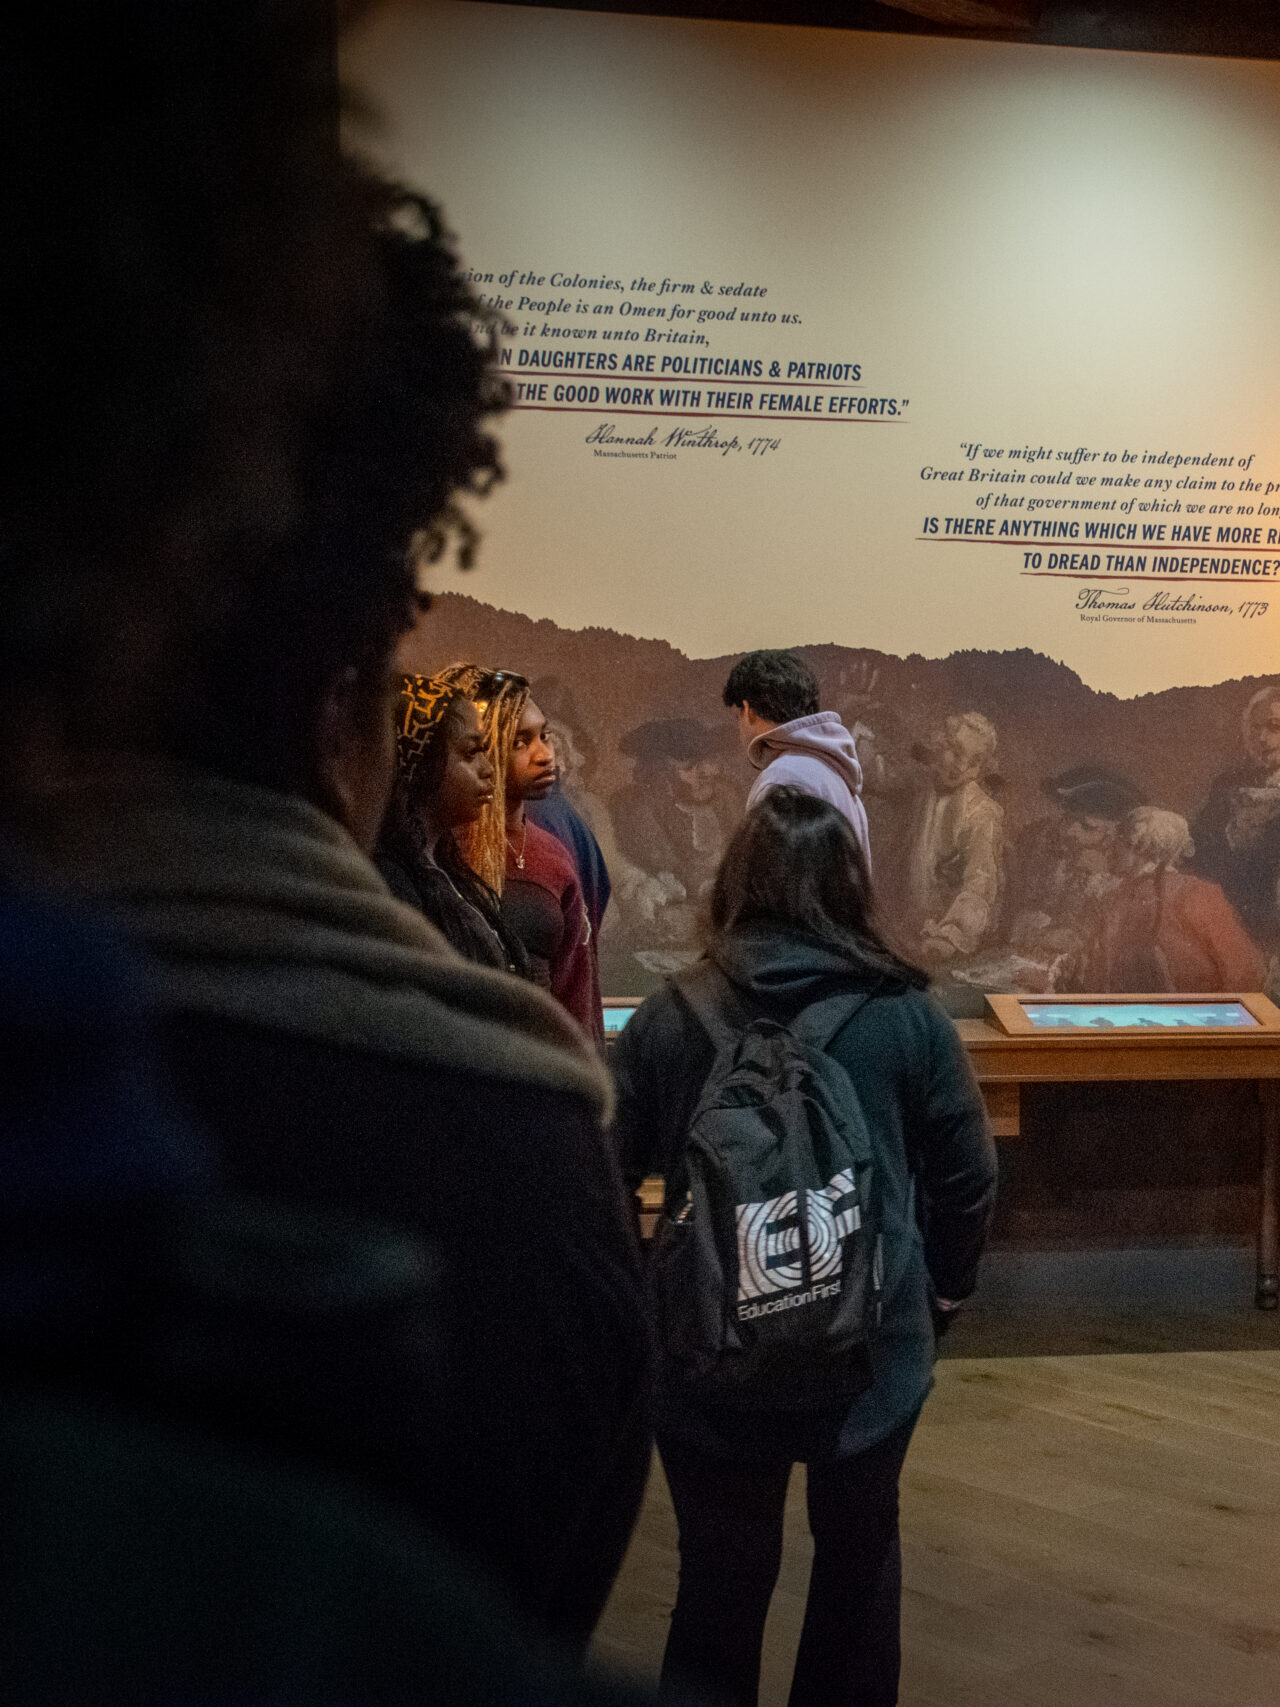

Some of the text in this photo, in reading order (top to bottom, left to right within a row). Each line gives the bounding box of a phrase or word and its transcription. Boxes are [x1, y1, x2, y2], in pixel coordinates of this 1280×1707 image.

[499, 270, 519, 288] of
[519, 271, 546, 286] the
[550, 273, 624, 293] Colonies,
[630, 277, 656, 292] the
[656, 278, 695, 296] firm
[700, 281, 712, 295] &
[718, 282, 767, 297] sedate
[487, 296, 512, 312] the
[518, 297, 571, 315] People
[576, 299, 589, 313] is
[593, 305, 613, 315] an
[619, 302, 666, 317] Omen
[667, 304, 695, 321] for
[697, 307, 736, 323] good
[740, 312, 776, 323] unto
[781, 313, 804, 326] us.
[501, 323, 518, 336] be
[523, 321, 536, 337] it
[540, 323, 597, 339] known
[602, 330, 639, 341] unto
[644, 328, 709, 346] Britain,
[519, 350, 617, 370] DAUGHTERS
[622, 354, 656, 372] ARE
[661, 356, 762, 376] POLITICIANS
[769, 361, 780, 377] &
[787, 361, 861, 381] PATRIOTS
[518, 384, 909, 416] THE GOOD WORK WITH THEIR FEMALE EFFORTS.”
[585, 423, 781, 456] Hannah Winthrop, 1774
[593, 449, 677, 460] Massachusetts Patriot
[983, 449, 1004, 458] we
[1008, 445, 1053, 463] might
[1056, 447, 1100, 465] suffer
[1103, 451, 1117, 462] to
[1121, 449, 1138, 463] be
[1142, 450, 1234, 468] independent
[1238, 454, 1256, 471] of
[920, 466, 964, 481] Great
[968, 468, 1025, 483] Britain
[1030, 471, 1073, 485] could
[1076, 476, 1096, 485] we
[1101, 474, 1140, 487] make
[1144, 479, 1172, 492] any
[1176, 476, 1217, 490] claim
[1221, 480, 1235, 490] to
[1239, 478, 1262, 492] the
[976, 493, 994, 510] of
[994, 493, 1025, 507] that
[1027, 499, 1116, 511] government
[1120, 498, 1137, 514] of
[1138, 499, 1181, 512] which
[1186, 504, 1206, 513] we
[1209, 505, 1233, 514] are
[1237, 506, 1254, 515] no
[923, 517, 939, 534] IS
[945, 518, 996, 535] THERE
[998, 520, 1079, 538] ANYTHING
[1085, 522, 1137, 539] WHICH
[1143, 524, 1166, 540] WE
[1171, 525, 1212, 542] HAVE
[1216, 527, 1262, 543] MORE
[1024, 553, 1042, 569] TO
[1048, 553, 1100, 570] DREAD
[1107, 555, 1147, 572] THAN
[1075, 587, 1269, 618] Thomas Hutchinson, 1773
[1080, 614, 1100, 623] Royal
[1147, 616, 1196, 624] Massachusetts
